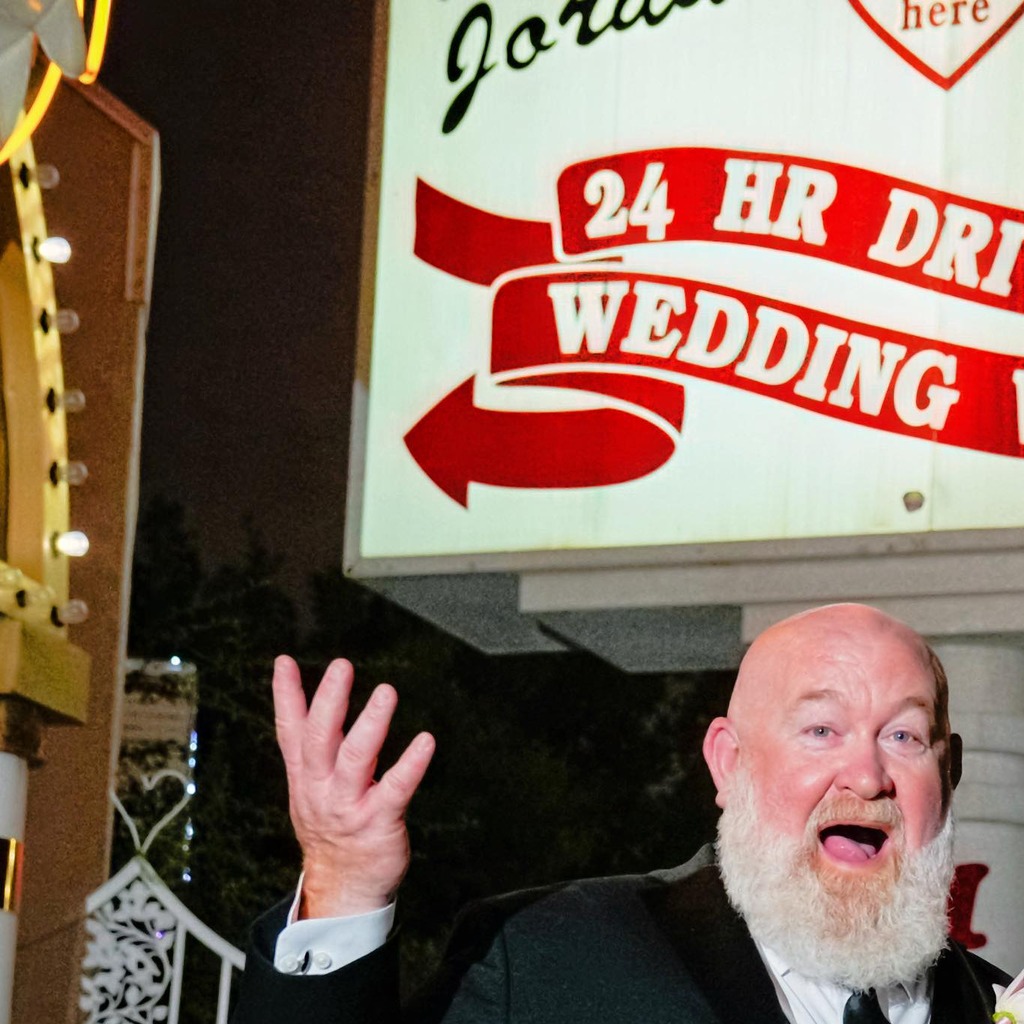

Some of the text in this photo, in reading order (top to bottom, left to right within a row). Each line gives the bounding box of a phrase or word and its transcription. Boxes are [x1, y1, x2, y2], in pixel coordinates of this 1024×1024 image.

[902, 0, 989, 31] here
[582, 162, 675, 242] 24
[713, 158, 838, 246] HR
[546, 280, 961, 431] WEDDING
